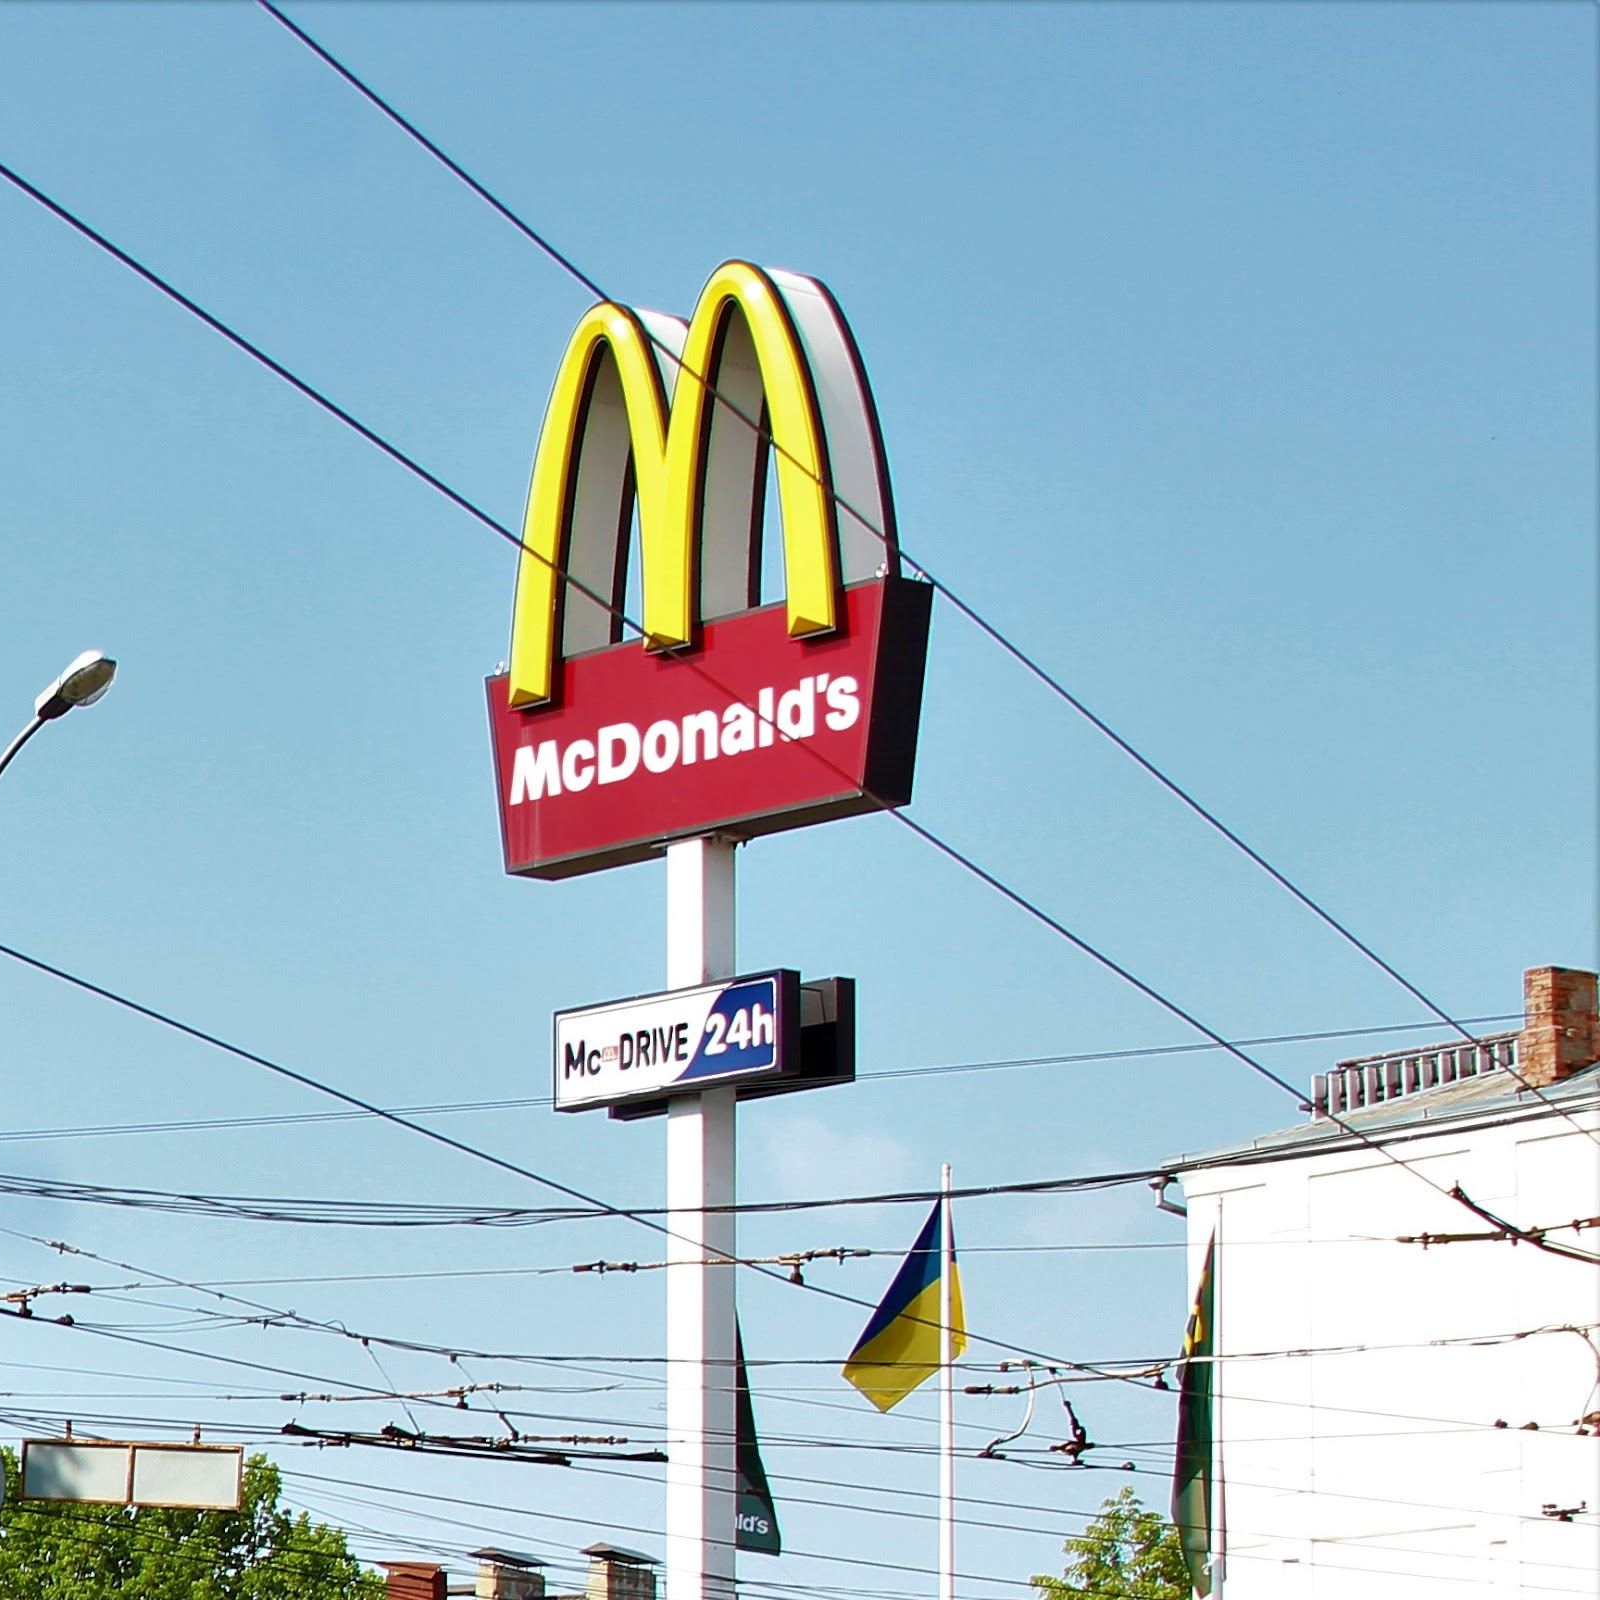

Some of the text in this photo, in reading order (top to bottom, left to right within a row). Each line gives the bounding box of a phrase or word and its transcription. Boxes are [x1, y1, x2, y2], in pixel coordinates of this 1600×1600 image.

[509, 673, 860, 806] McDonald's
[564, 1003, 774, 1080] Mc DRIVE 24h
[735, 1513, 768, 1534] ld's
